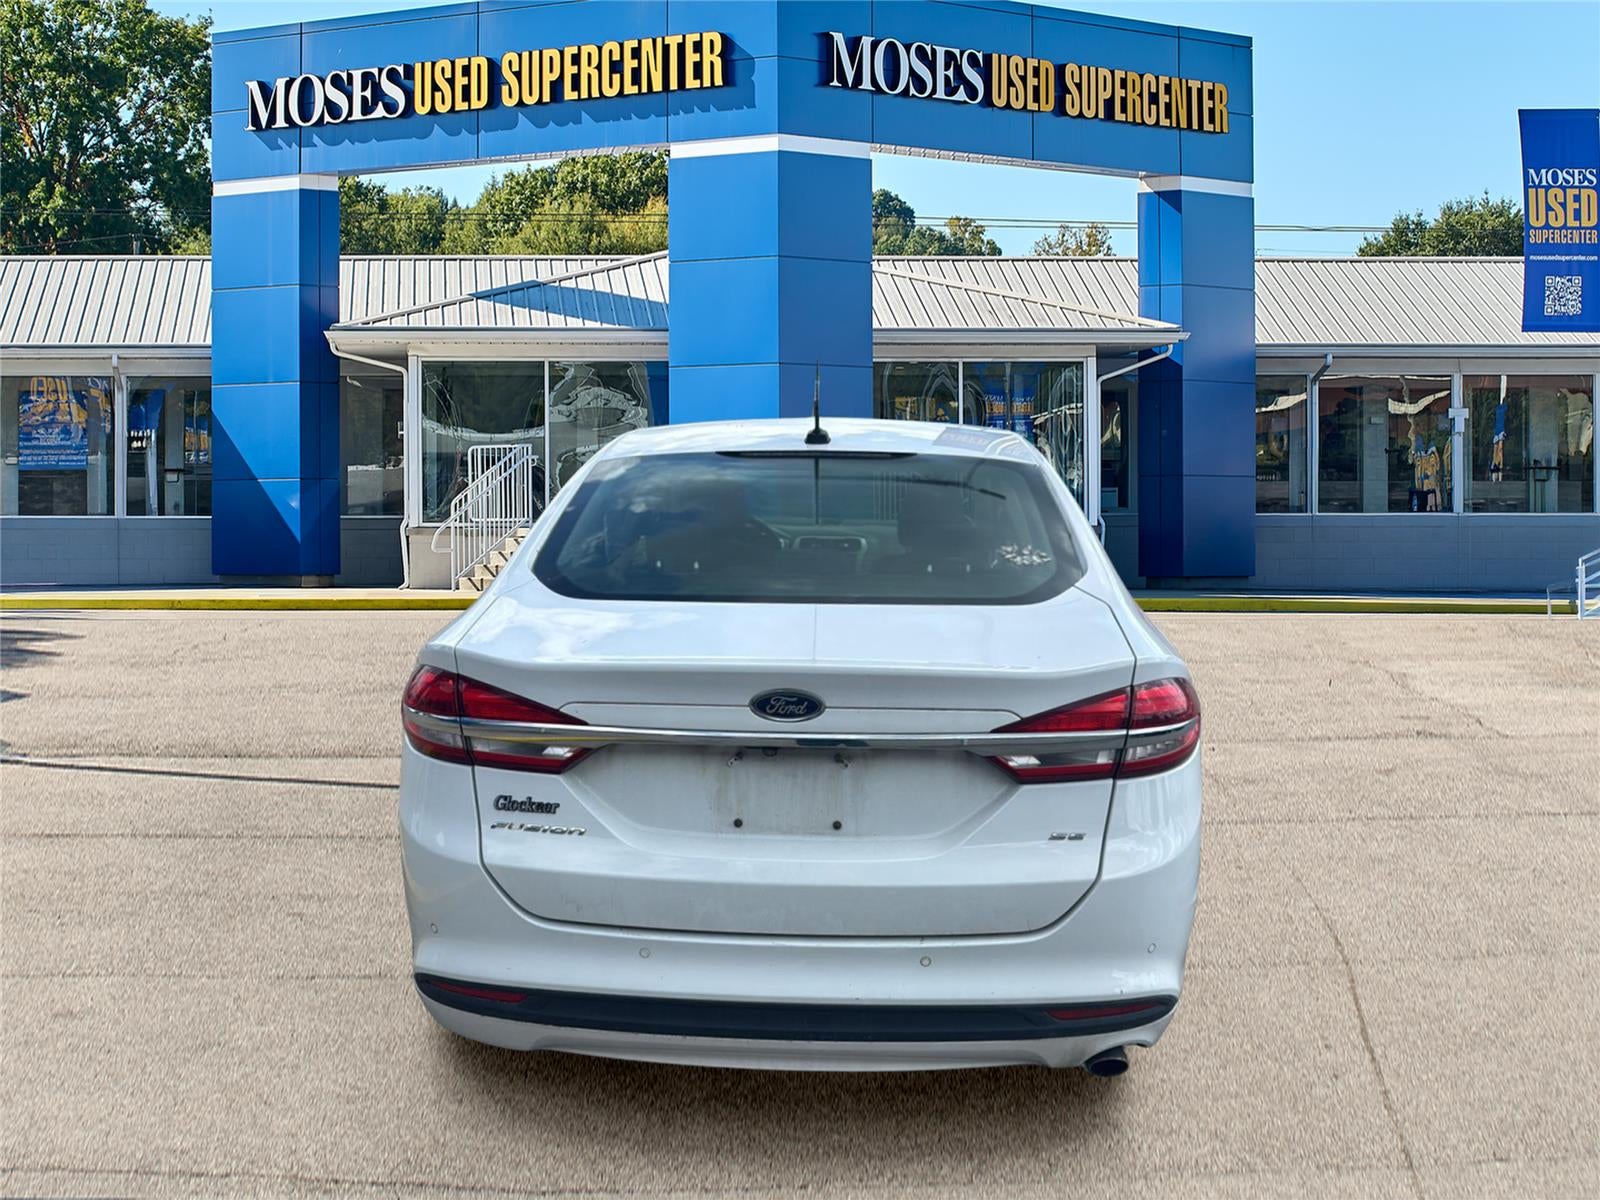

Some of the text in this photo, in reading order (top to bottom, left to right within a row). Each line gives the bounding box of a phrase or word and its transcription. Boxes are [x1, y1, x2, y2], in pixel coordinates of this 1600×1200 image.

[245, 31, 724, 131] MOSES USED SUPERCENTER
[829, 31, 1229, 133] MOSES USED SUPERCENTER
[1527, 168, 1597, 186] MOSES
[1528, 188, 1597, 227] USED
[1529, 229, 1598, 244] SUPERCENTER
[766, 695, 808, 714] Ford
